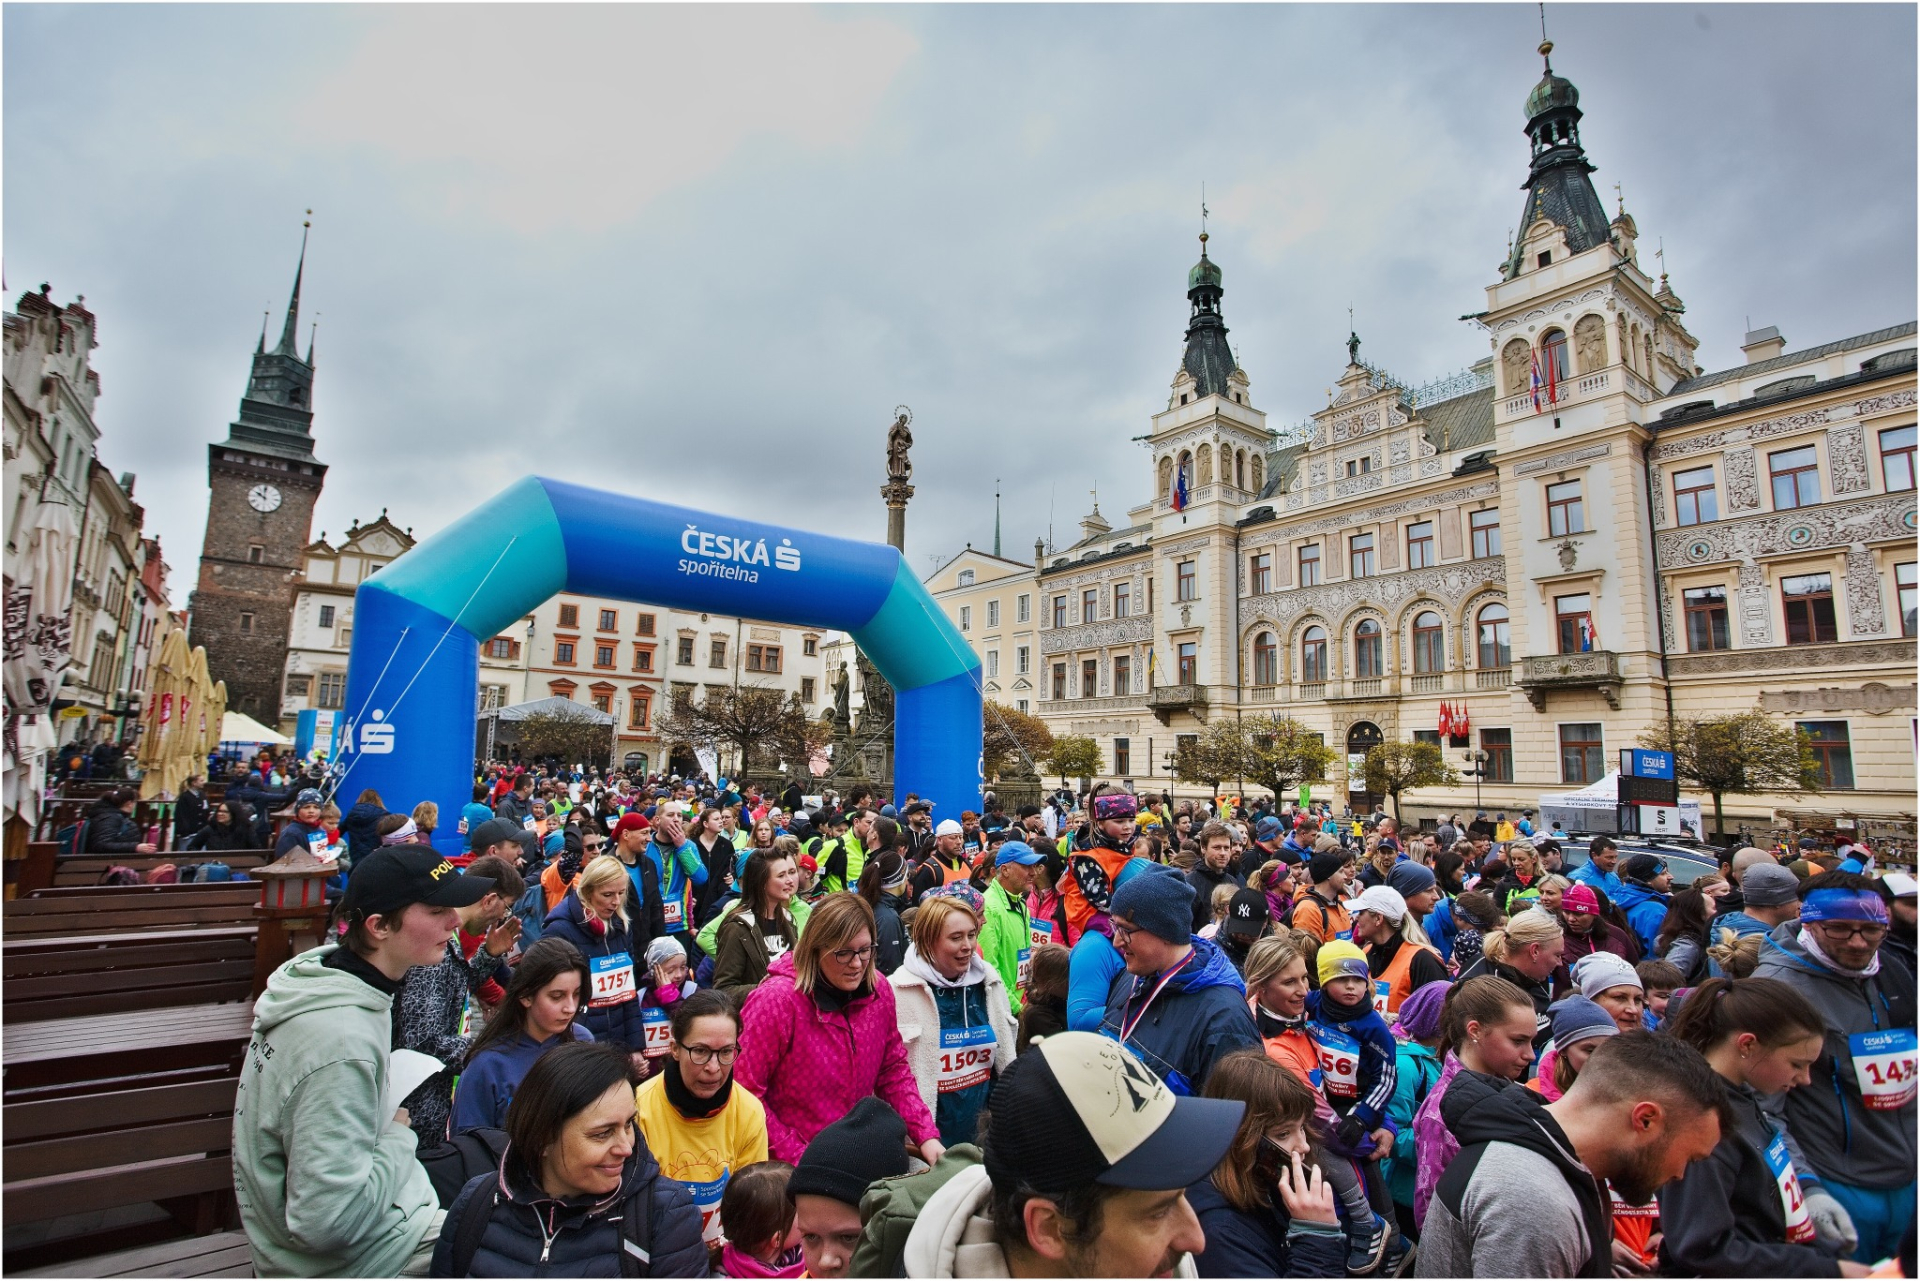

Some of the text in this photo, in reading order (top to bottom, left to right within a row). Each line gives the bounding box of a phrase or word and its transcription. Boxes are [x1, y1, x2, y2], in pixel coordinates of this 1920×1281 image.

[682, 524, 770, 567] ČESKÁ
[678, 559, 759, 583] spořitelna
[1642, 755, 1660, 768] ČESKÁ
[1238, 903, 1250, 917] NY
[597, 970, 630, 992] 1757
[646, 1025, 674, 1041] 75
[945, 1032, 963, 1040] ČESKÁ
[939, 1048, 991, 1072] 1503
